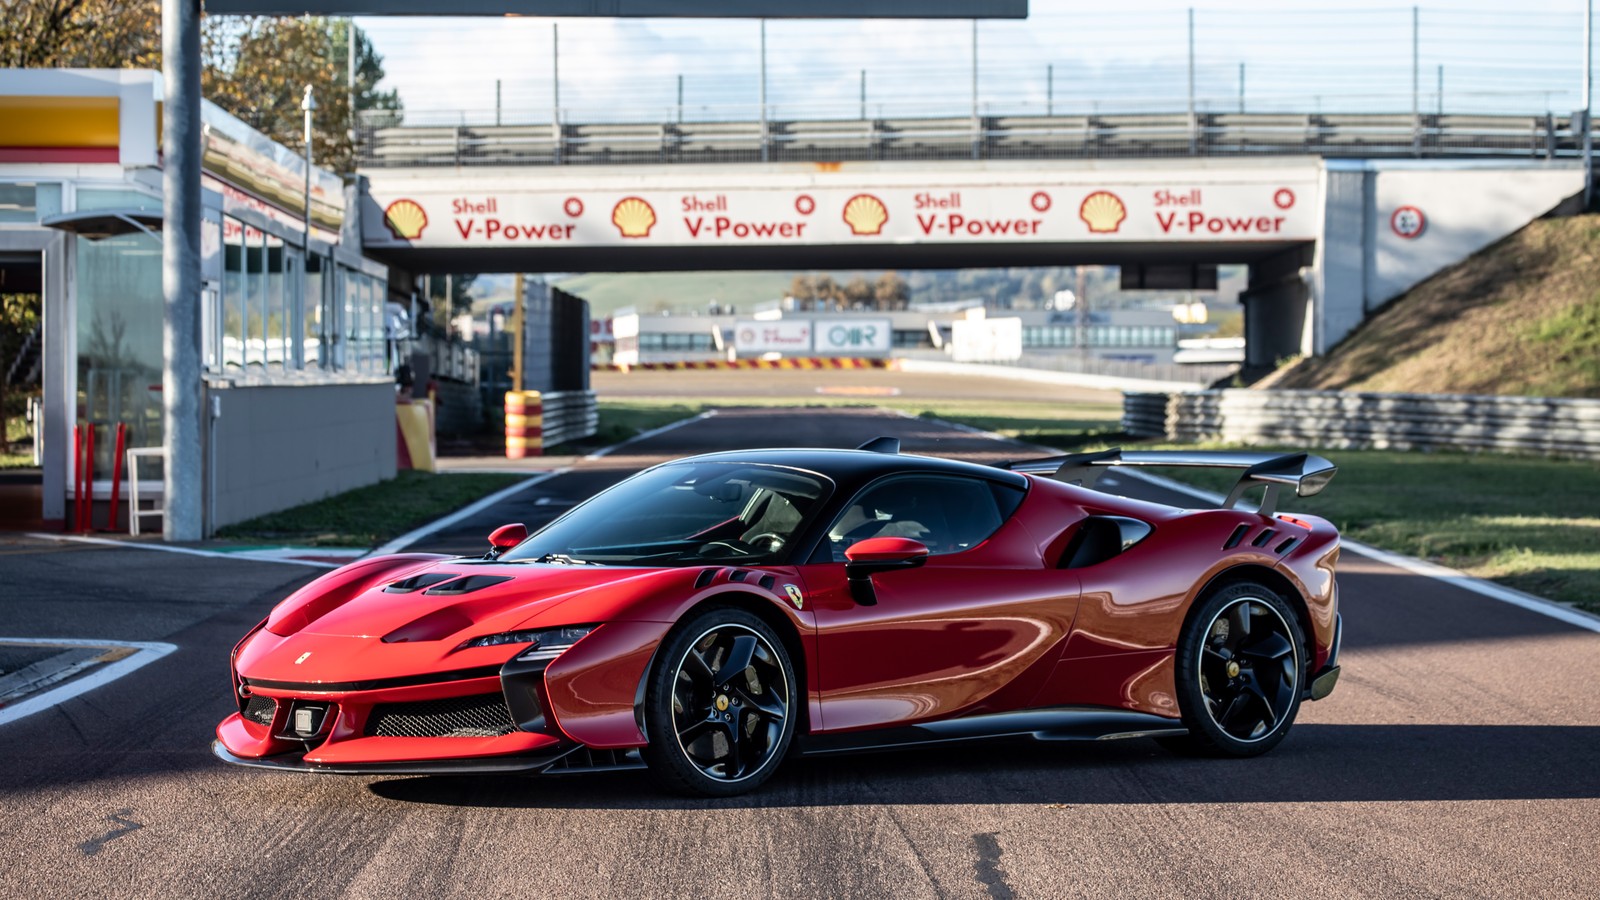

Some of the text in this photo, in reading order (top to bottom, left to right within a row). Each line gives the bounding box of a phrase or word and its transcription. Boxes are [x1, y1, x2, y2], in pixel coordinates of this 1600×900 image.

[452, 198, 498, 215] Shell
[681, 196, 727, 213] Shell
[914, 193, 961, 209] Shell
[1153, 189, 1201, 207] Shell
[454, 217, 576, 241] V-Power
[683, 214, 807, 239] V-Power
[915, 213, 1042, 236] V-Power
[1155, 211, 1286, 235] V-Power
